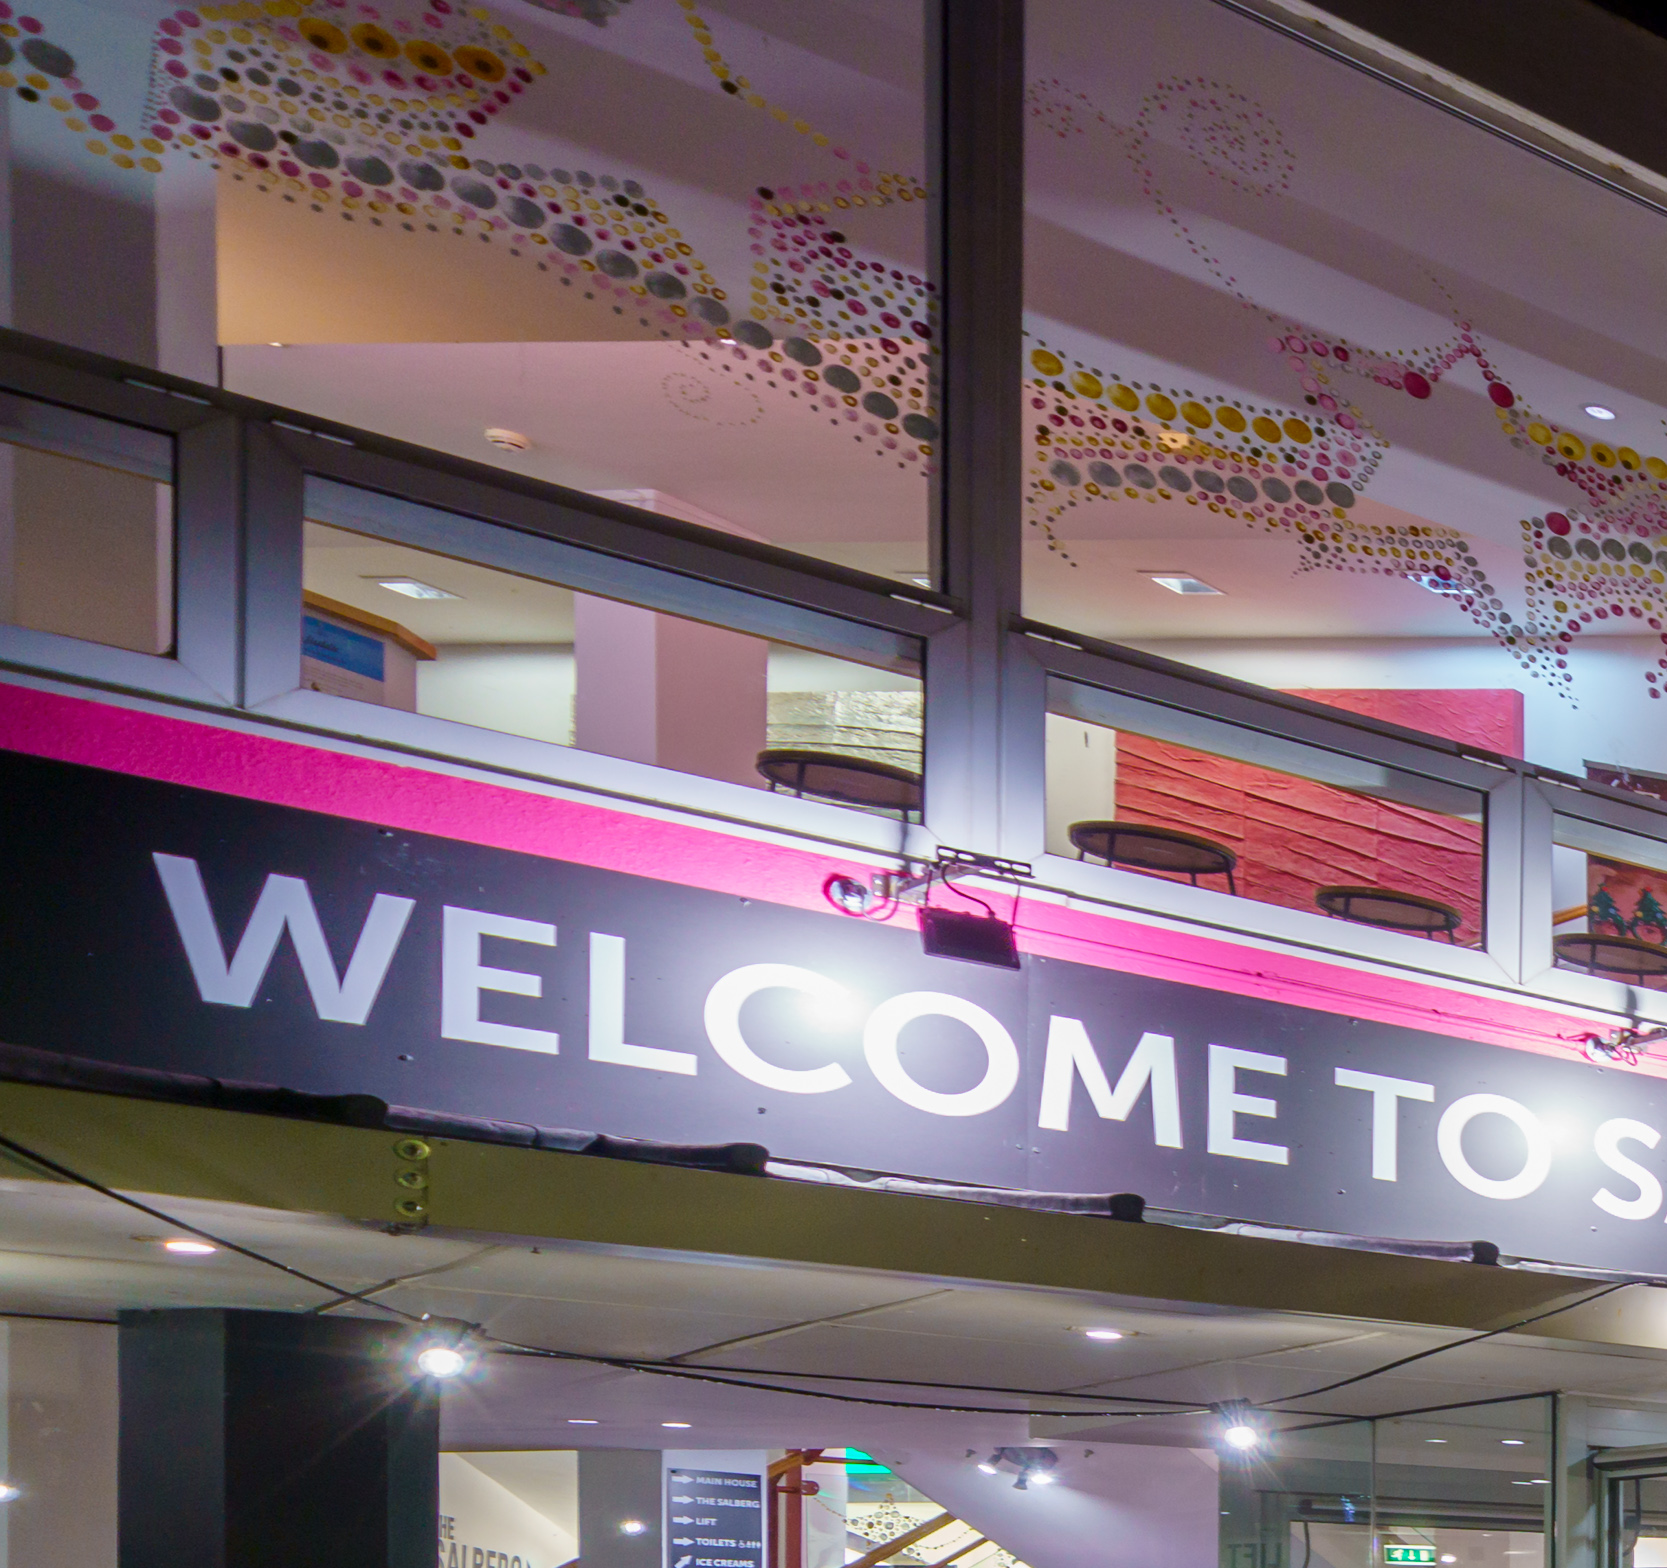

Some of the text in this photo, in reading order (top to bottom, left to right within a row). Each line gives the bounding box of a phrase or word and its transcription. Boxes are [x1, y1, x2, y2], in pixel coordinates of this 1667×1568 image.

[153, 852, 1289, 1164] WELCOME
[1335, 1067, 1551, 1200] TO
[696, 1477, 757, 1488] MAIN HOUSE
[696, 1497, 760, 1508] THE SALBERG
[439, 1515, 454, 1540] HE
[696, 1518, 717, 1526] LIFT
[696, 1537, 736, 1548] TOILETS
[696, 1558, 755, 1568] ICE CREAMS
